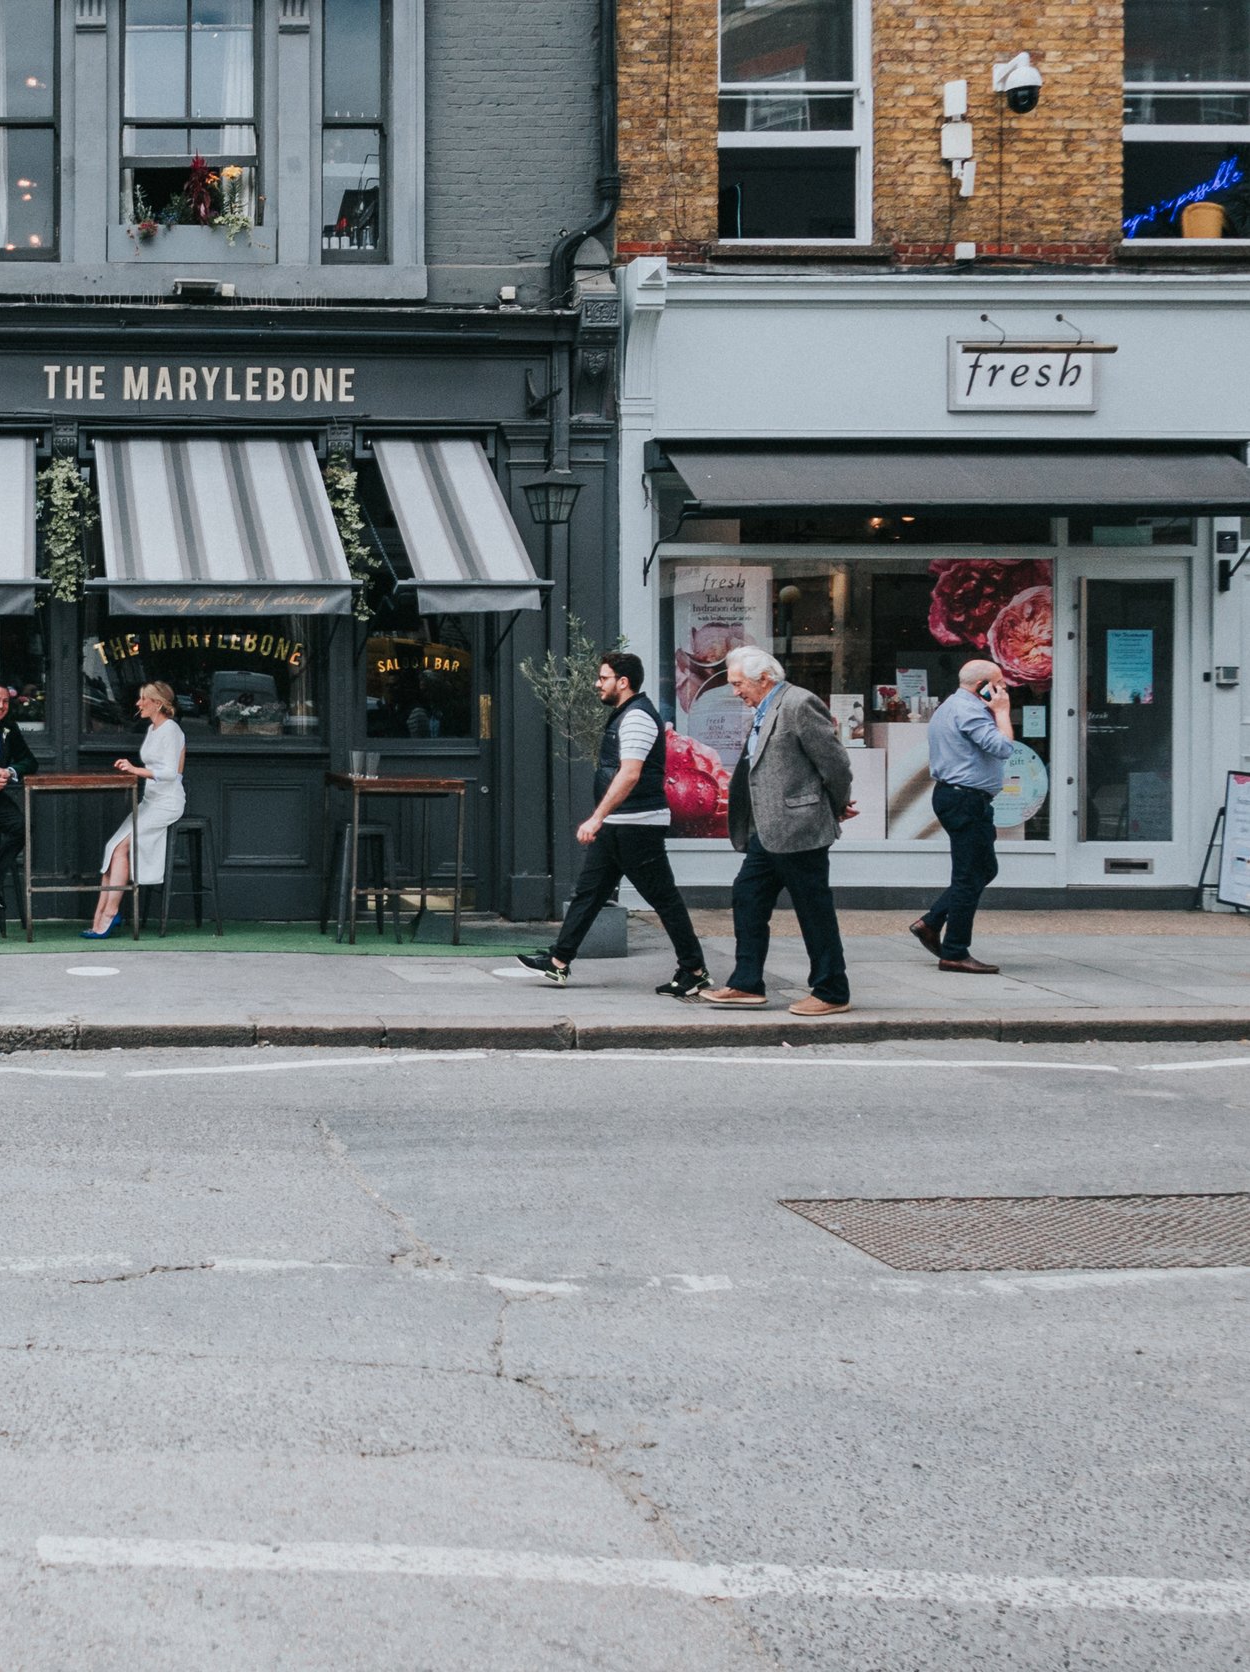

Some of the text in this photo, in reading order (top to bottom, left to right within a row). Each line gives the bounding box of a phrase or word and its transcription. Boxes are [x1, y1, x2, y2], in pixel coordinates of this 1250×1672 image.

[43, 365, 355, 402] THE MARYLEBONE
[966, 352, 1082, 397] fresh
[702, 573, 746, 593] fresh
[252, 590, 272, 612] of
[706, 594, 744, 604] Take your
[693, 604, 729, 615] hydration
[93, 628, 304, 666] THE MARYLEBONE
[434, 657, 460, 673] BAR
[1010, 758, 1025, 767] gift
